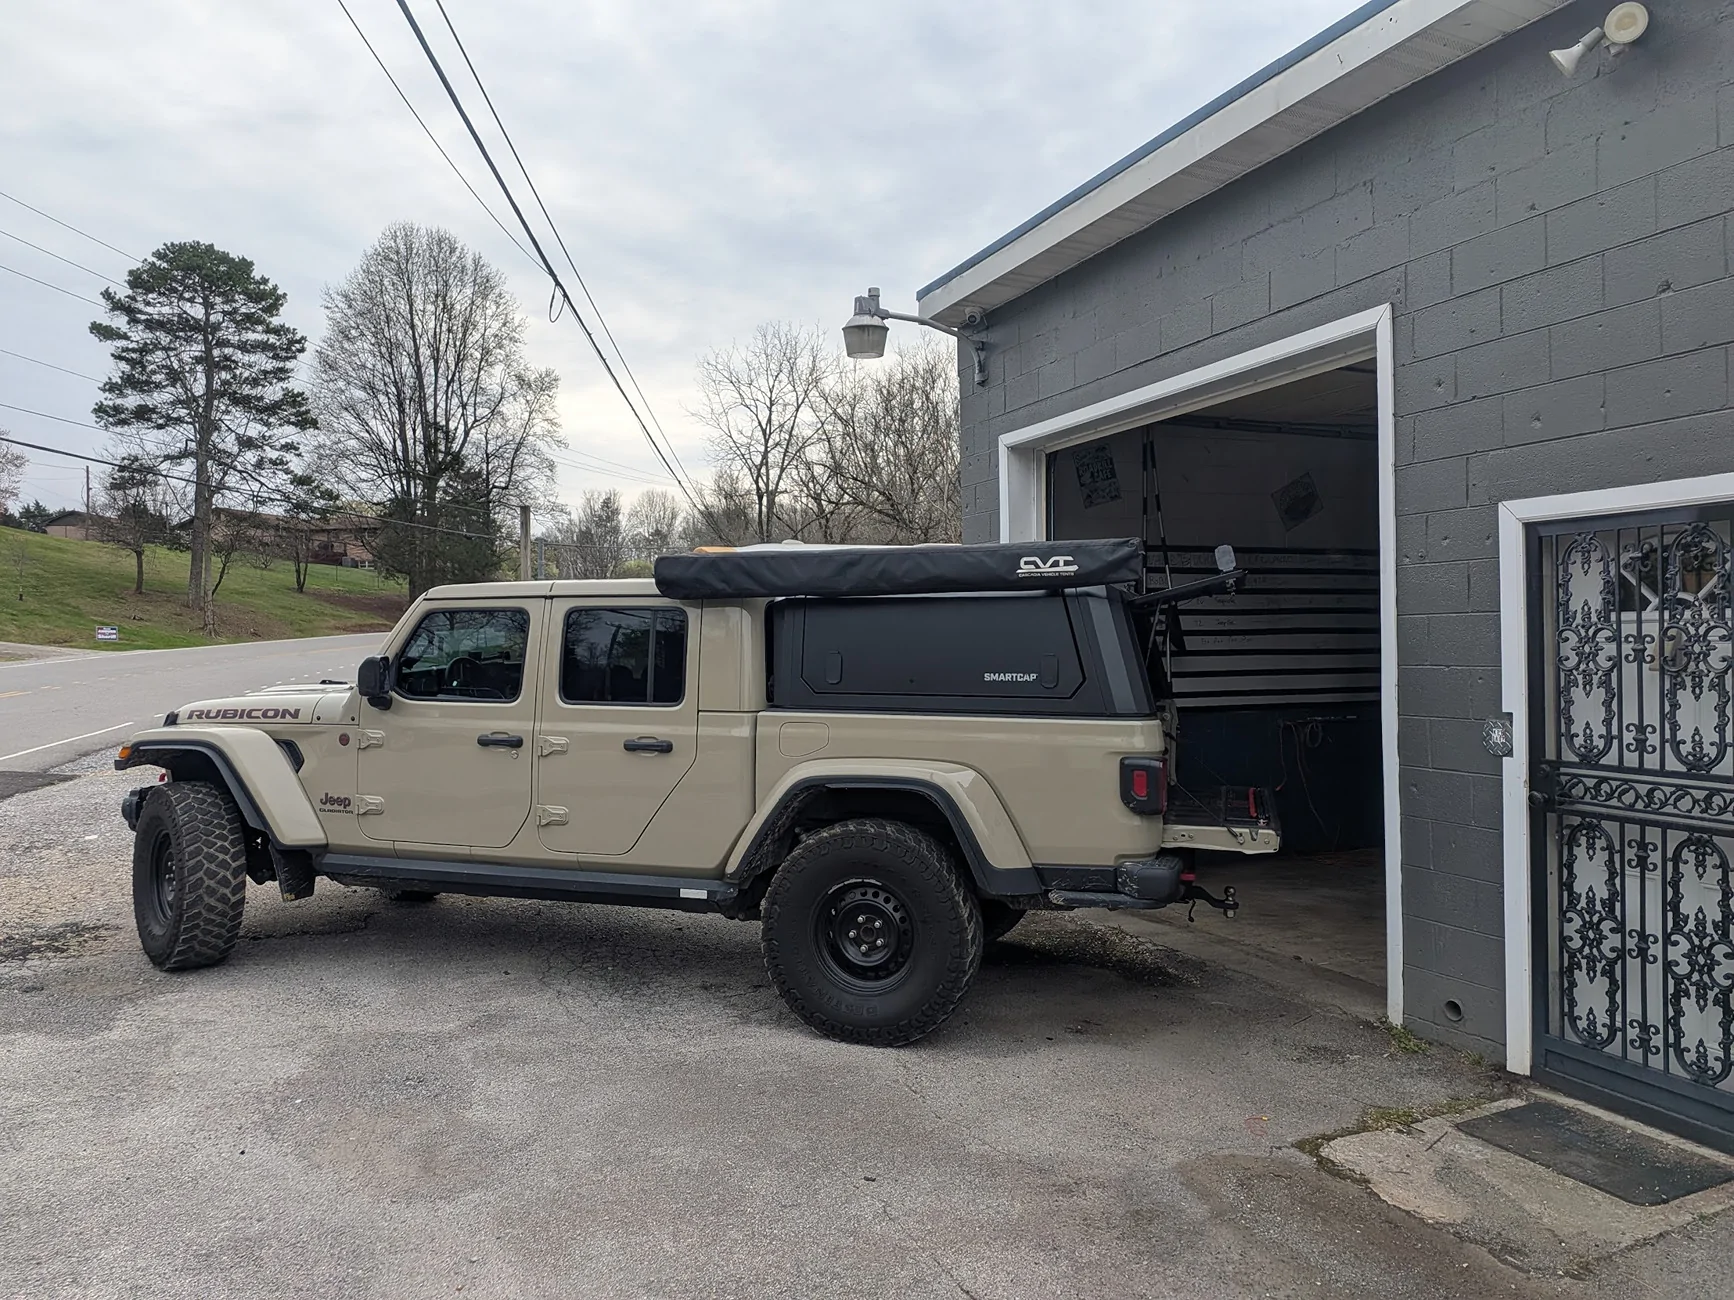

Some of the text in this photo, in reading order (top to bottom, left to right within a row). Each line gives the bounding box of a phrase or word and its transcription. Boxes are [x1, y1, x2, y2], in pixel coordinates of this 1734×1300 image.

[1020, 556, 1074, 569] CVT
[984, 673, 1037, 682] SMARTCAP
[187, 708, 302, 720] RUBICON
[320, 792, 352, 809] Jeep
[319, 807, 354, 815] GLADIATOR
